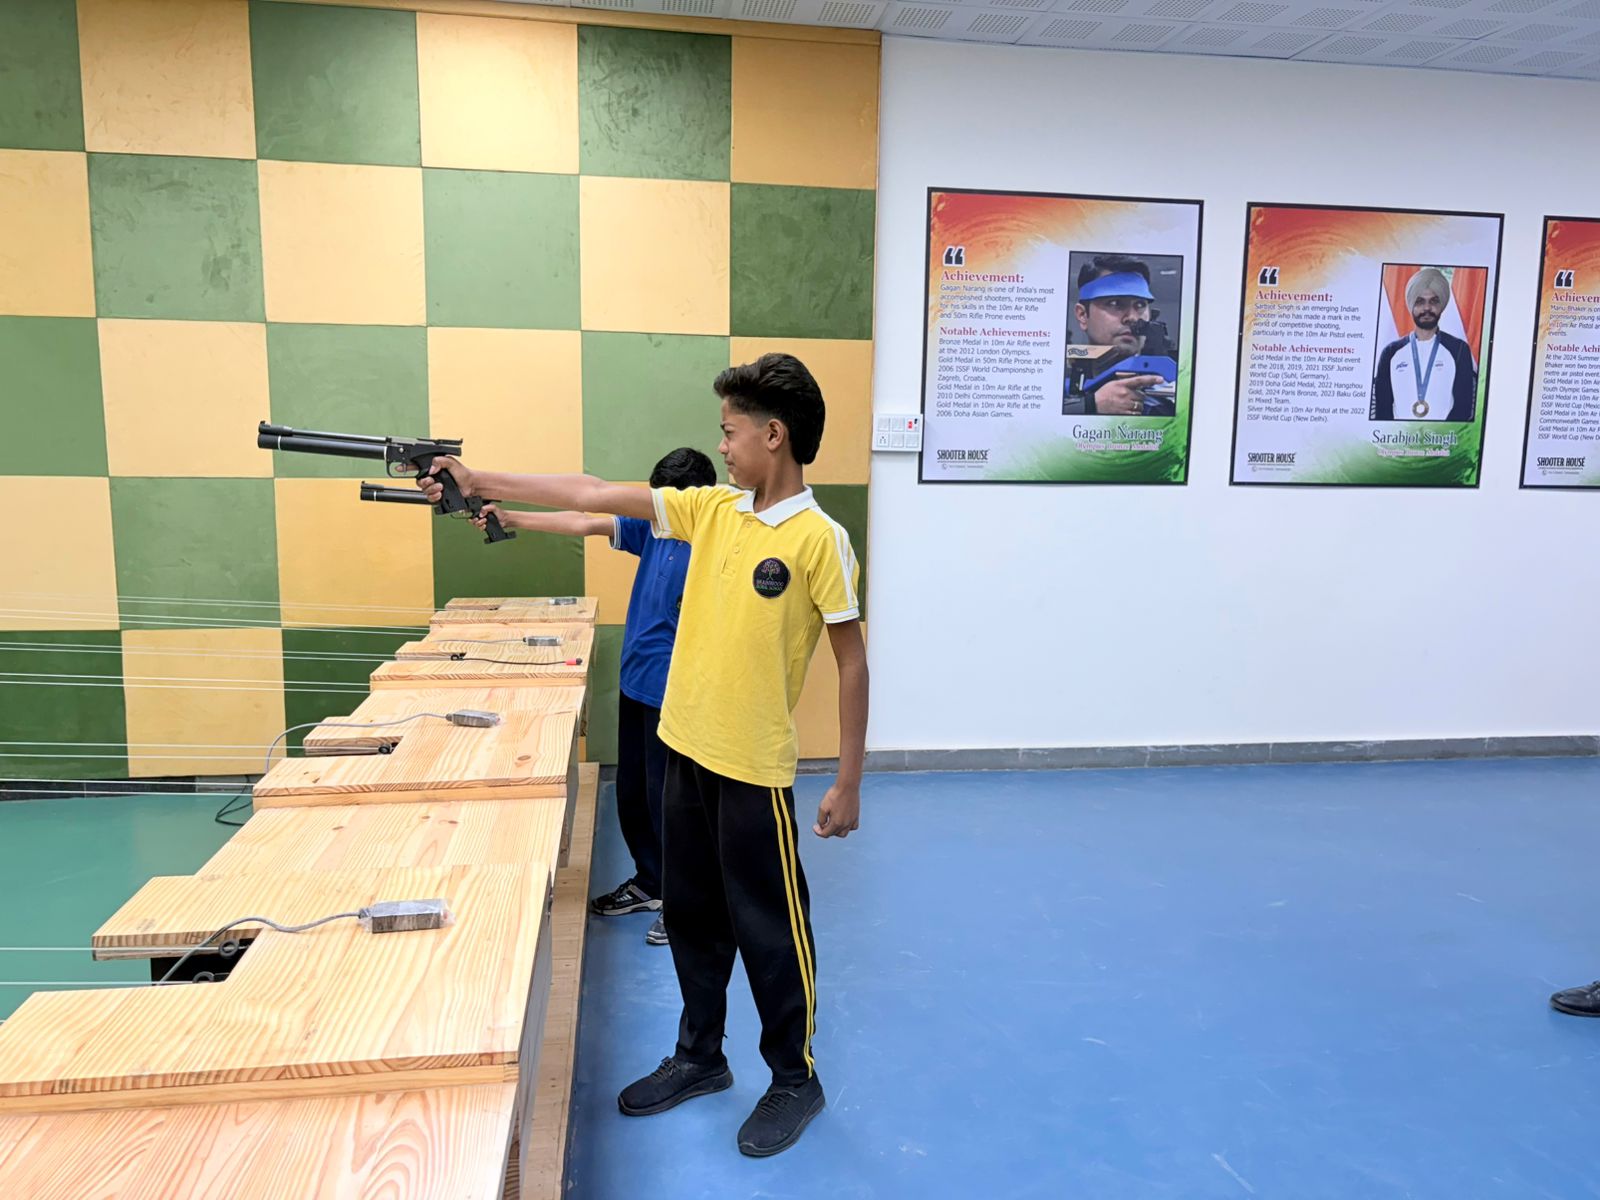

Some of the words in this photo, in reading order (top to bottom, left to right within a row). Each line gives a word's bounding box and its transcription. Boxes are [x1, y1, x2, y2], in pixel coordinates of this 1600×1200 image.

[942, 270, 1024, 282] Achievement:
[1256, 290, 1333, 302] Achievement:
[940, 326, 977, 336] Notable
[980, 328, 1051, 337] Achievements:
[1252, 343, 1287, 352] Notable
[1289, 344, 1355, 353] Achievements:
[1073, 424, 1111, 442] Gagan
[1117, 425, 1163, 442] Narang
[1372, 430, 1419, 445] Sarabjot
[1424, 431, 1456, 447] Singh
[937, 450, 966, 460] SHOOTER
[968, 450, 988, 460] HOUSE
[1248, 453, 1274, 462] SHOOTER
[1276, 453, 1295, 463] HOUSE
[1537, 457, 1564, 466] SHOOTER
[1566, 457, 1584, 467] HOUSE
